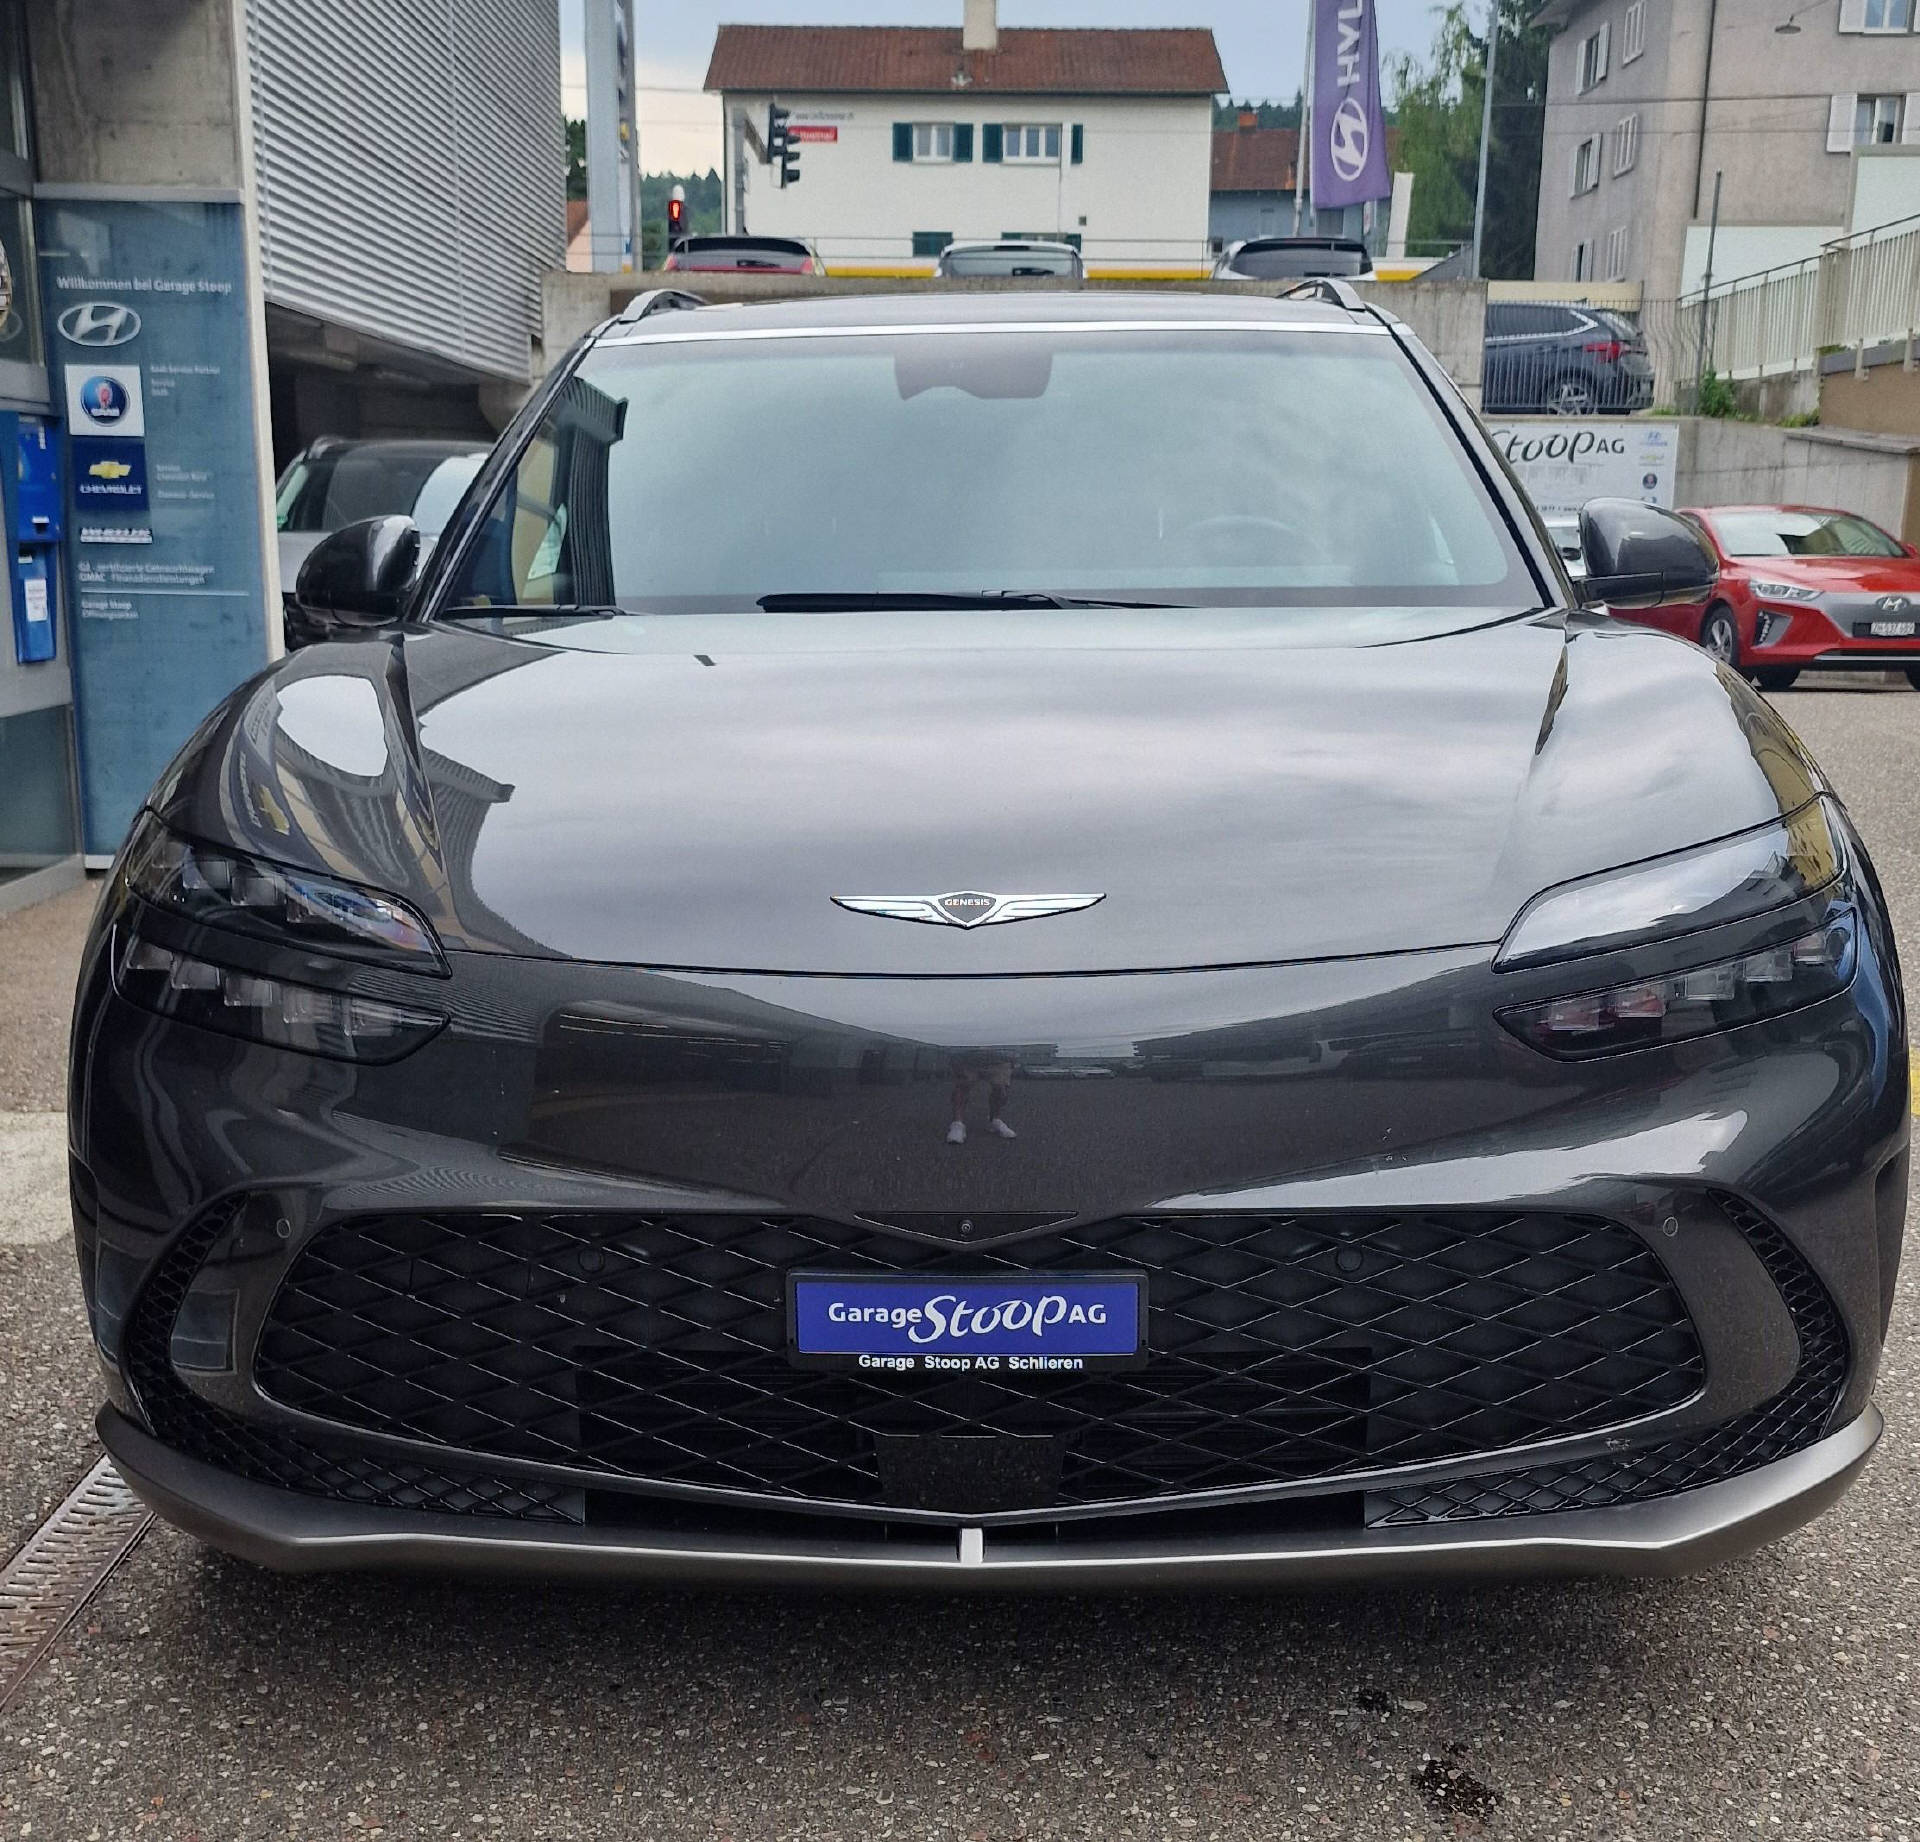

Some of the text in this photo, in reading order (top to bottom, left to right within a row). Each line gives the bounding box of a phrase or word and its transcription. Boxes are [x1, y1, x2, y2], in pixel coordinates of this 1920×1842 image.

[56, 275, 232, 296] Willkommen bei Garage Stoop
[1491, 429, 1625, 464] toop AG
[944, 898, 990, 907] GENESIS
[828, 1295, 1107, 1344] Garage Stoop AG
[859, 1355, 1084, 1371] Garage Stoop AG Schlieren
